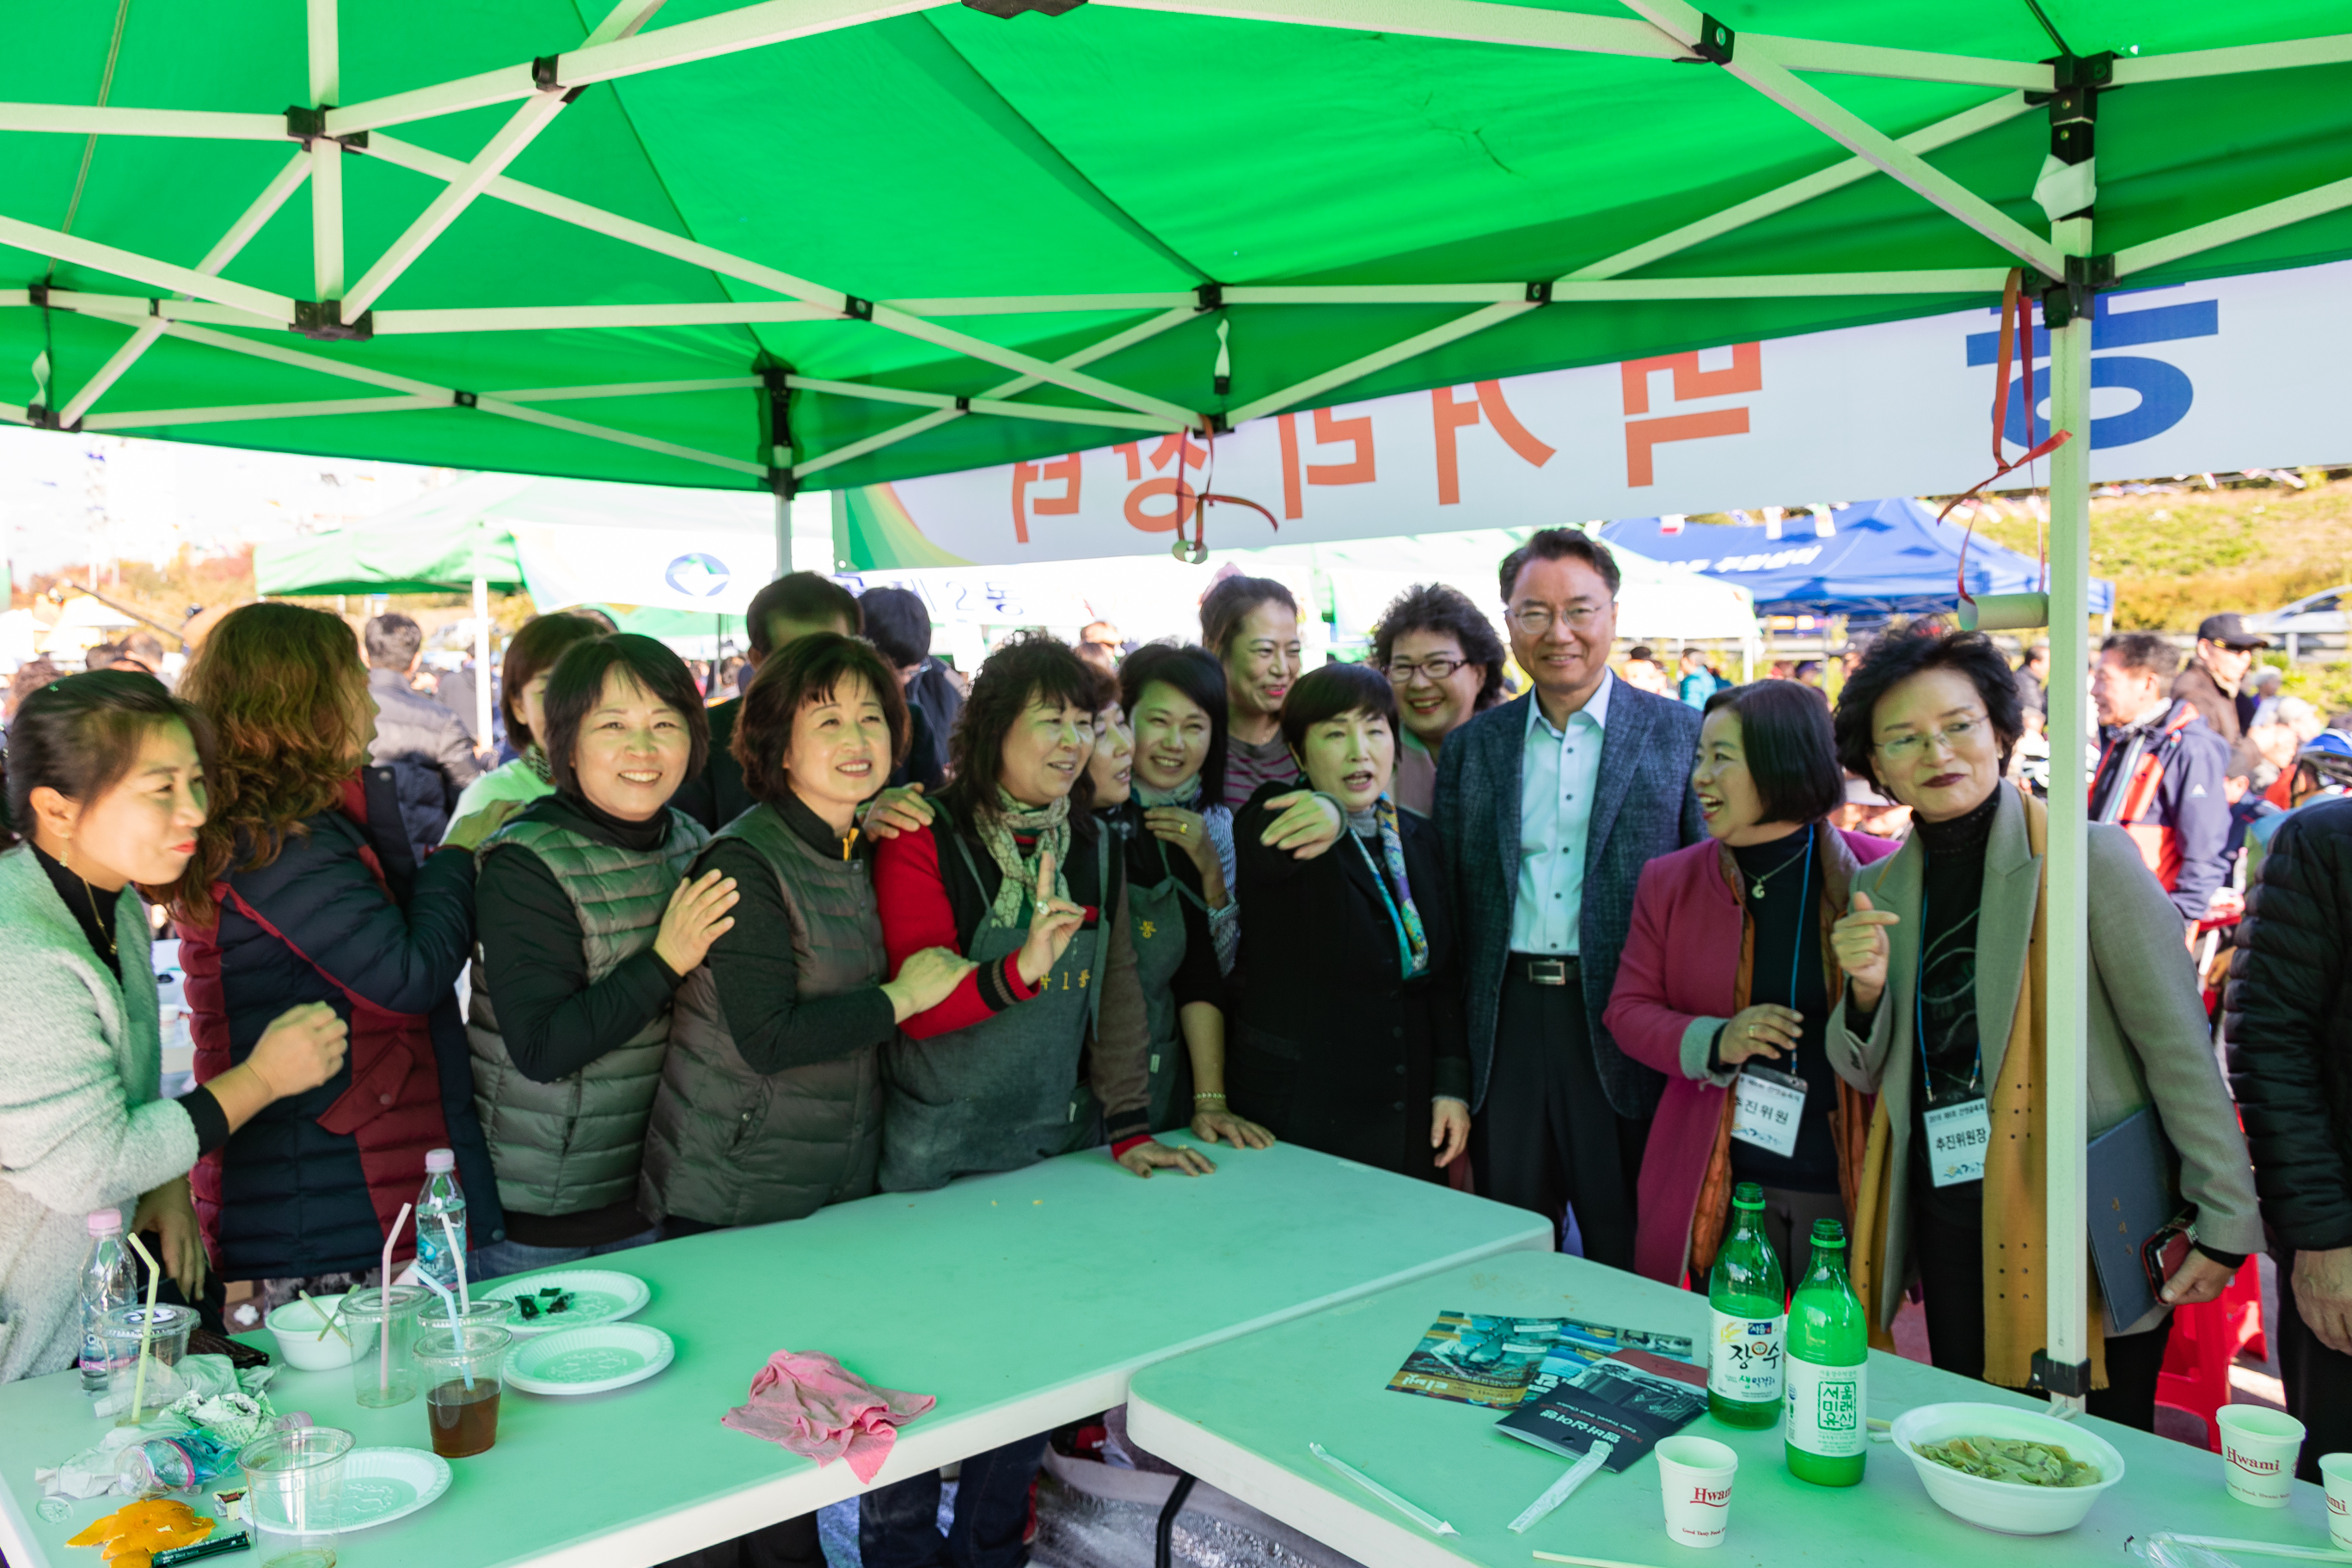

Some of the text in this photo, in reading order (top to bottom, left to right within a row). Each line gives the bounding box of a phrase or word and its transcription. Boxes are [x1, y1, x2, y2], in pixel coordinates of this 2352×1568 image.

[1935, 1127, 1988, 1152] 추진위원장
[1729, 1341, 1780, 1369] 장수
[1823, 1386, 1853, 1400] 서울
[1822, 1401, 1853, 1412] 미래
[1823, 1412, 1853, 1427] 유산
[2226, 1445, 2281, 1471] Hwami
